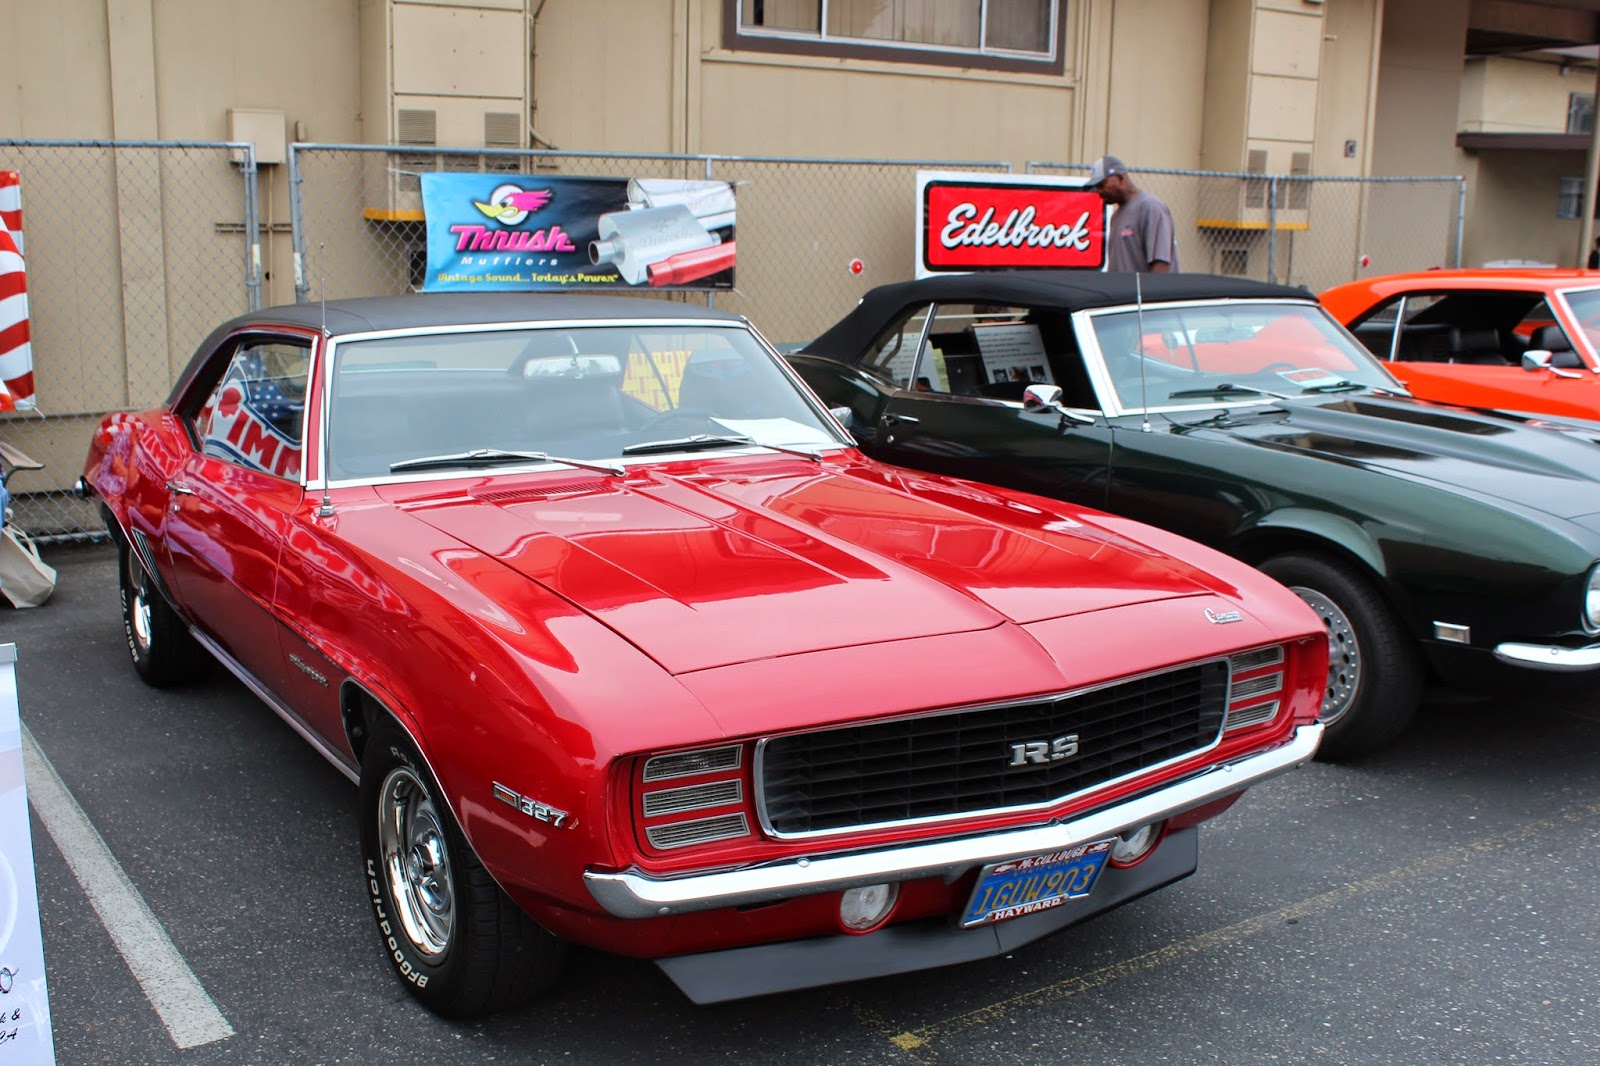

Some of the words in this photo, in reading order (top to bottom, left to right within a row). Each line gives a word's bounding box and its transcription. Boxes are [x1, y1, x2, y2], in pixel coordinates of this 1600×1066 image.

[450, 225, 576, 252] Thrush
[940, 202, 1091, 251] Edelbrock
[461, 256, 558, 266] Mufflers
[437, 273, 483, 284] Vintage
[532, 273, 577, 285] Today's
[1009, 734, 1080, 767] RS
[520, 797, 569, 828] 327
[973, 864, 1096, 916] 1GUW903
[367, 859, 429, 989] BFGoodrich
[994, 897, 1063, 921] HAYWARD
